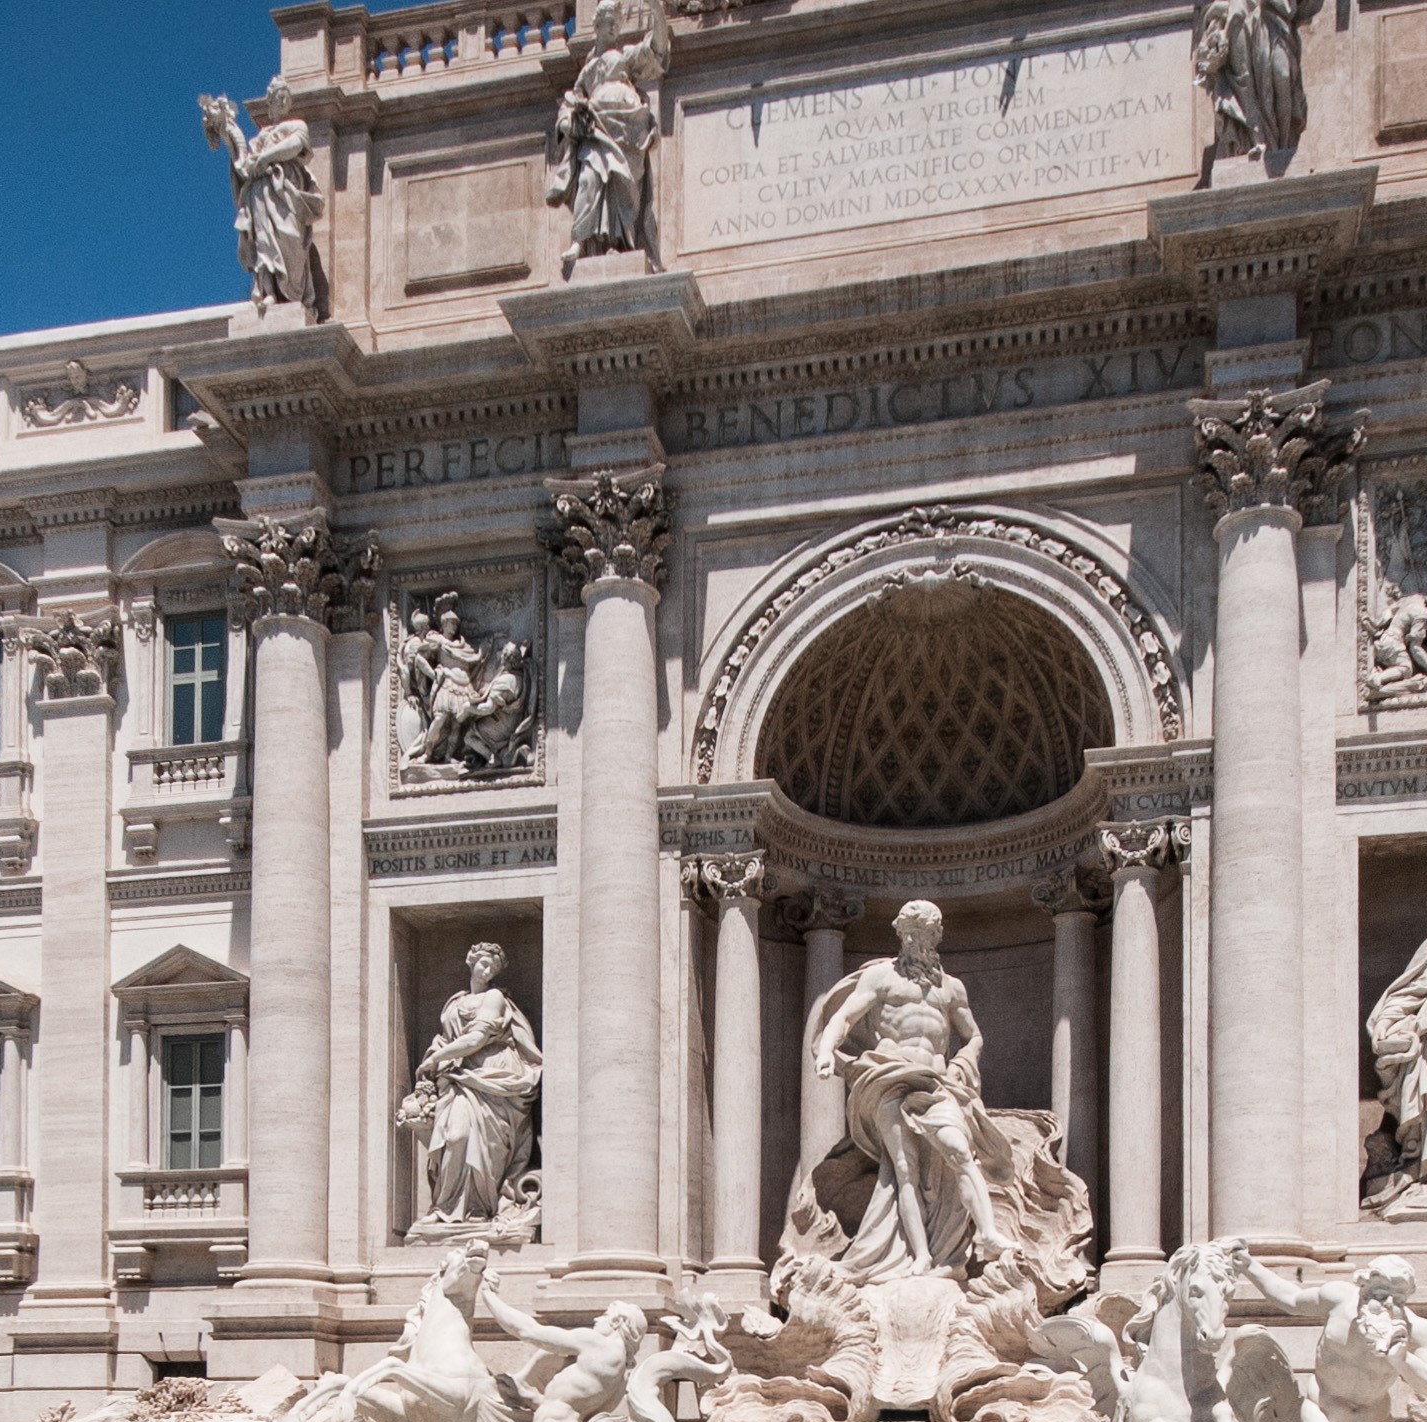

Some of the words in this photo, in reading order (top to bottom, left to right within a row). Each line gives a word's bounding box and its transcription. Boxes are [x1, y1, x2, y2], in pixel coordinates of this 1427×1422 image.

[700, 161, 767, 187] COPIA
[777, 153, 803, 175] ET
[811, 128, 963, 170] SALVBRITATE
[976, 92, 1173, 142] COMMENDATAM
[818, 110, 905, 143] AQVAM
[921, 86, 1045, 124] VIRGINEM
[758, 174, 833, 203] CVLTV
[847, 151, 985, 190] MAGNIFICO
[997, 128, 1112, 165] ORNAVIT
[709, 210, 777, 238] ANNO
[785, 195, 873, 227] DOMINI
[685, 366, 1035, 451] BENEDICTVS
[347, 427, 578, 495] PERFECIT
[1336, 776, 1418, 799] SOLVTVM
[372, 855, 427, 875] POSITIS
[433, 851, 481, 870] SIGNIS
[491, 849, 510, 866] ET
